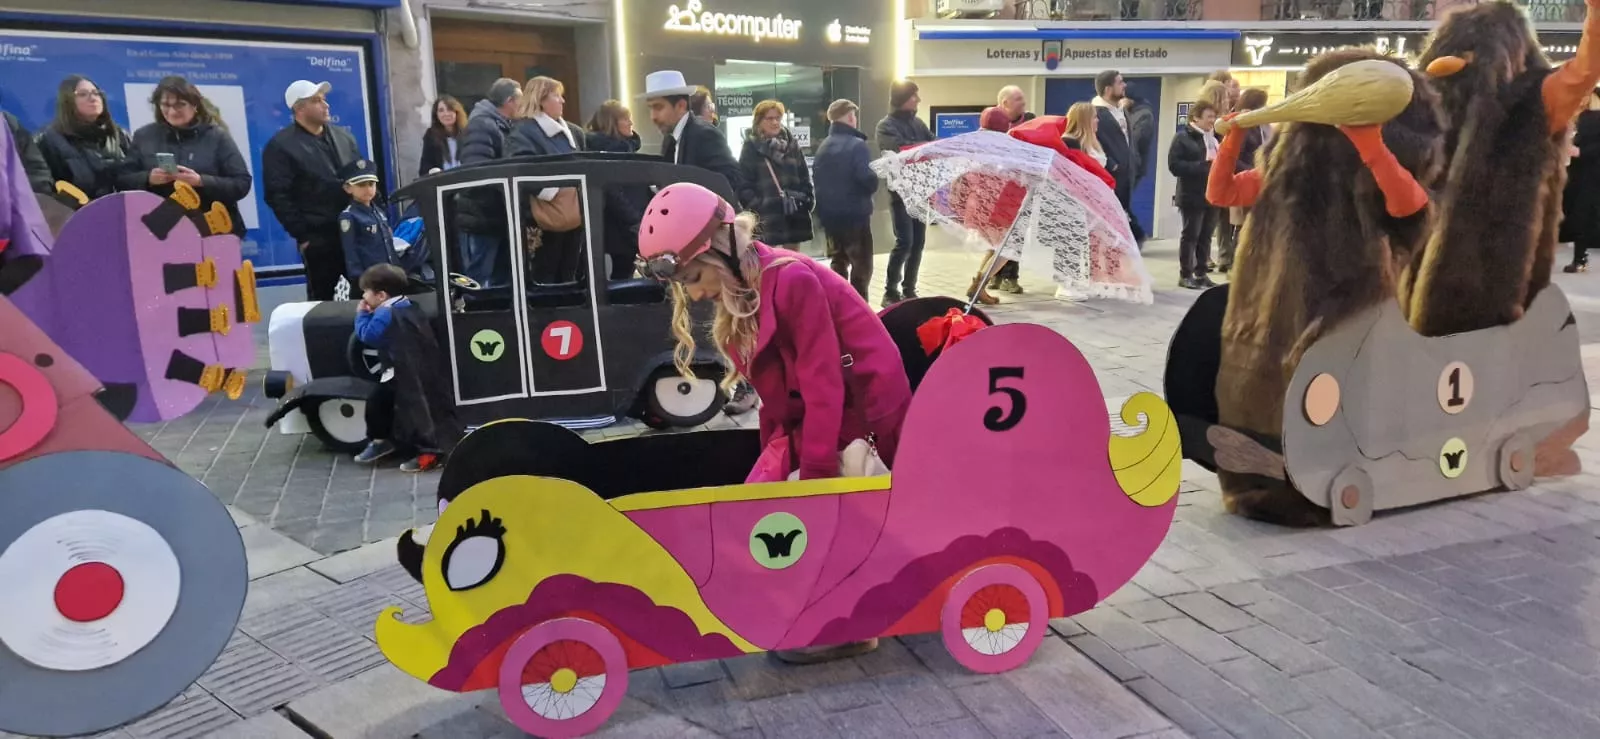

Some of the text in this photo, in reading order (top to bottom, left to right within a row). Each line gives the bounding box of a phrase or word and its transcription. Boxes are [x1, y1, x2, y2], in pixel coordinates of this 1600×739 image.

[701, 11, 802, 42] ecomputer
[1033, 50, 1041, 61] y
[1064, 47, 1168, 60] Apuestas del Estado
[550, 326, 573, 356] 7
[983, 366, 1027, 432] 5
[1447, 367, 1464, 407] 1
